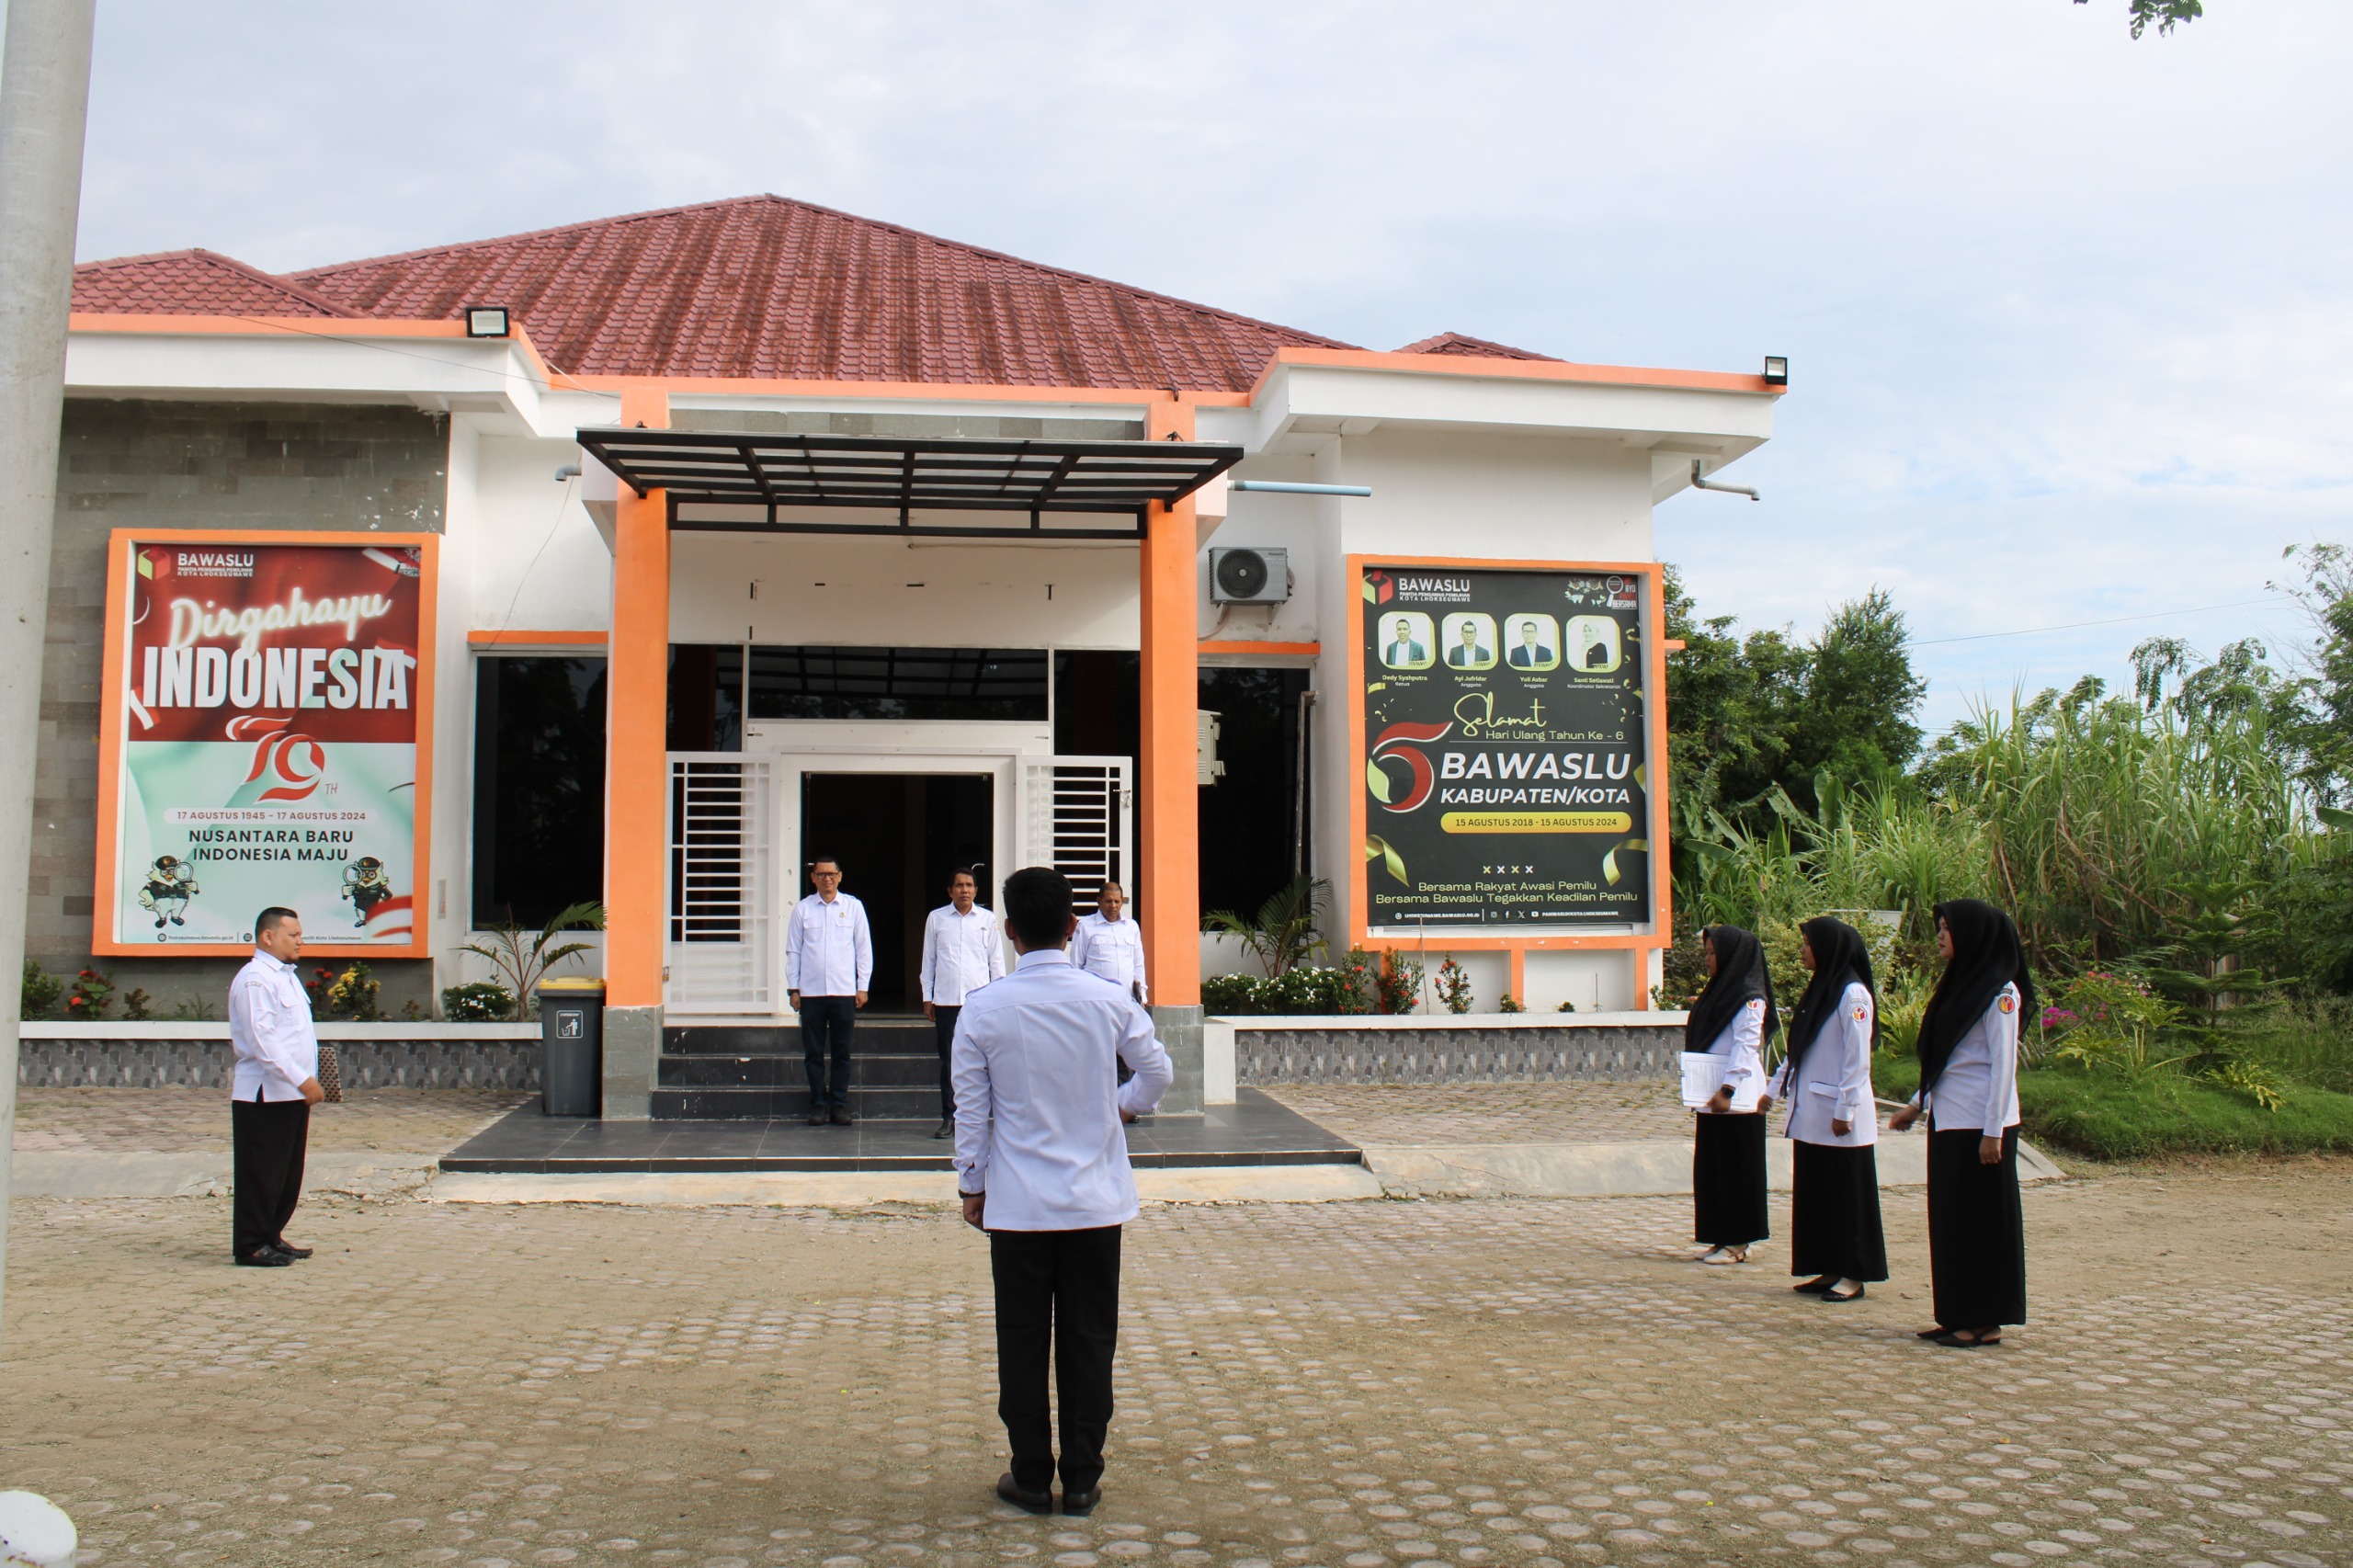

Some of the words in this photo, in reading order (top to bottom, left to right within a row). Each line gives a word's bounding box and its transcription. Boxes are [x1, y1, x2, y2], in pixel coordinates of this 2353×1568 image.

[177, 552, 254, 566] BAWASLU
[1399, 578, 1471, 592] BAWASLU
[168, 586, 392, 657] Dirgahayu
[142, 645, 409, 710] INDONESIA
[1454, 691, 1548, 736] Selamat
[1486, 731, 1509, 740] Hari
[1513, 731, 1545, 741] Ulang
[1549, 731, 1586, 740] Tahun
[1588, 731, 1603, 740] Ke
[1615, 732, 1624, 740] 6
[1440, 753, 1631, 779] BAWASLU
[324, 782, 338, 795] TH
[1440, 786, 1631, 805] KABUPATEN/KOTA
[177, 812, 188, 820] 17
[189, 812, 239, 820] AGUSTUS
[242, 812, 266, 820] 1945
[277, 812, 287, 820] 17
[290, 812, 338, 820] AGUSTUS
[340, 812, 367, 820] 2024
[188, 830, 300, 843] NUSANTARA
[305, 830, 354, 843] BARU
[193, 848, 291, 860] INDONESIA
[297, 848, 348, 861] MAJU
[1418, 882, 1472, 892] Bersama
[1475, 882, 1517, 893] Rakyat
[1519, 881, 1555, 891] Awasi
[1558, 881, 1597, 890] Pemilu
[1376, 894, 1429, 903] Bersama
[1433, 893, 1483, 903] Bawaslu
[1486, 893, 1543, 904] Tegakkan
[1547, 892, 1597, 902] Keadilan
[1599, 892, 1638, 901] Pemilu
